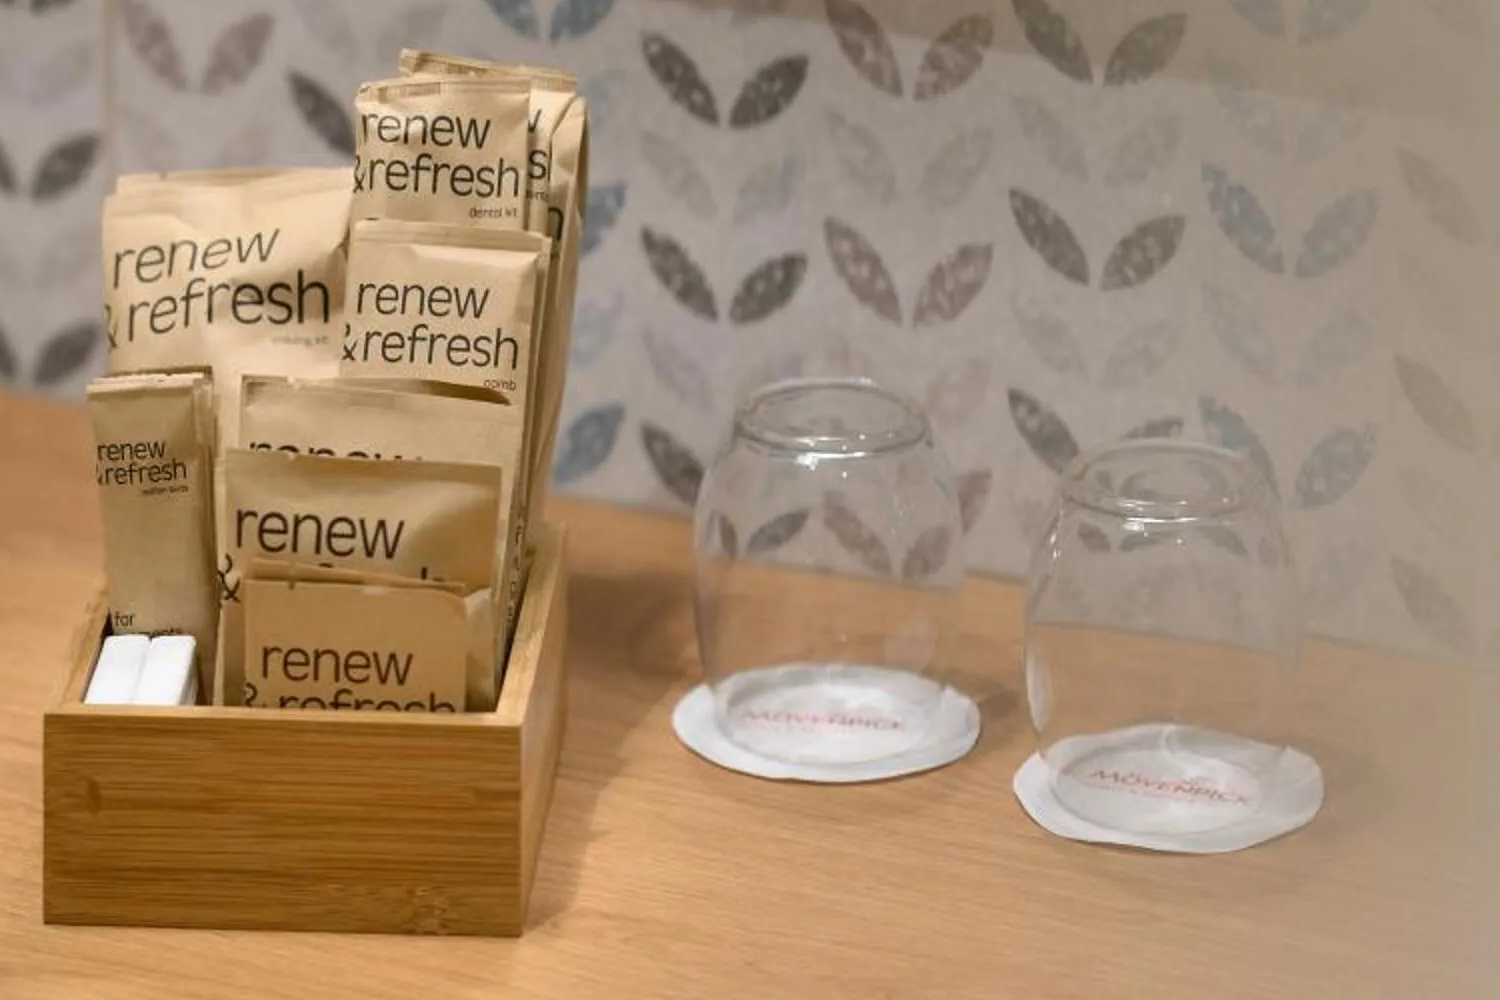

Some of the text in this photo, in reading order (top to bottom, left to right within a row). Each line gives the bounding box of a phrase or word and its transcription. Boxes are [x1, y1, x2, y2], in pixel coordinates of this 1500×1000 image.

[361, 112, 491, 149] renew
[113, 228, 280, 289] renew
[128, 269, 329, 342] refresh
[356, 282, 490, 319] renew
[97, 441, 165, 461] renew
[105, 458, 187, 485] refresh
[236, 508, 404, 560] renew
[262, 645, 414, 686] renew
